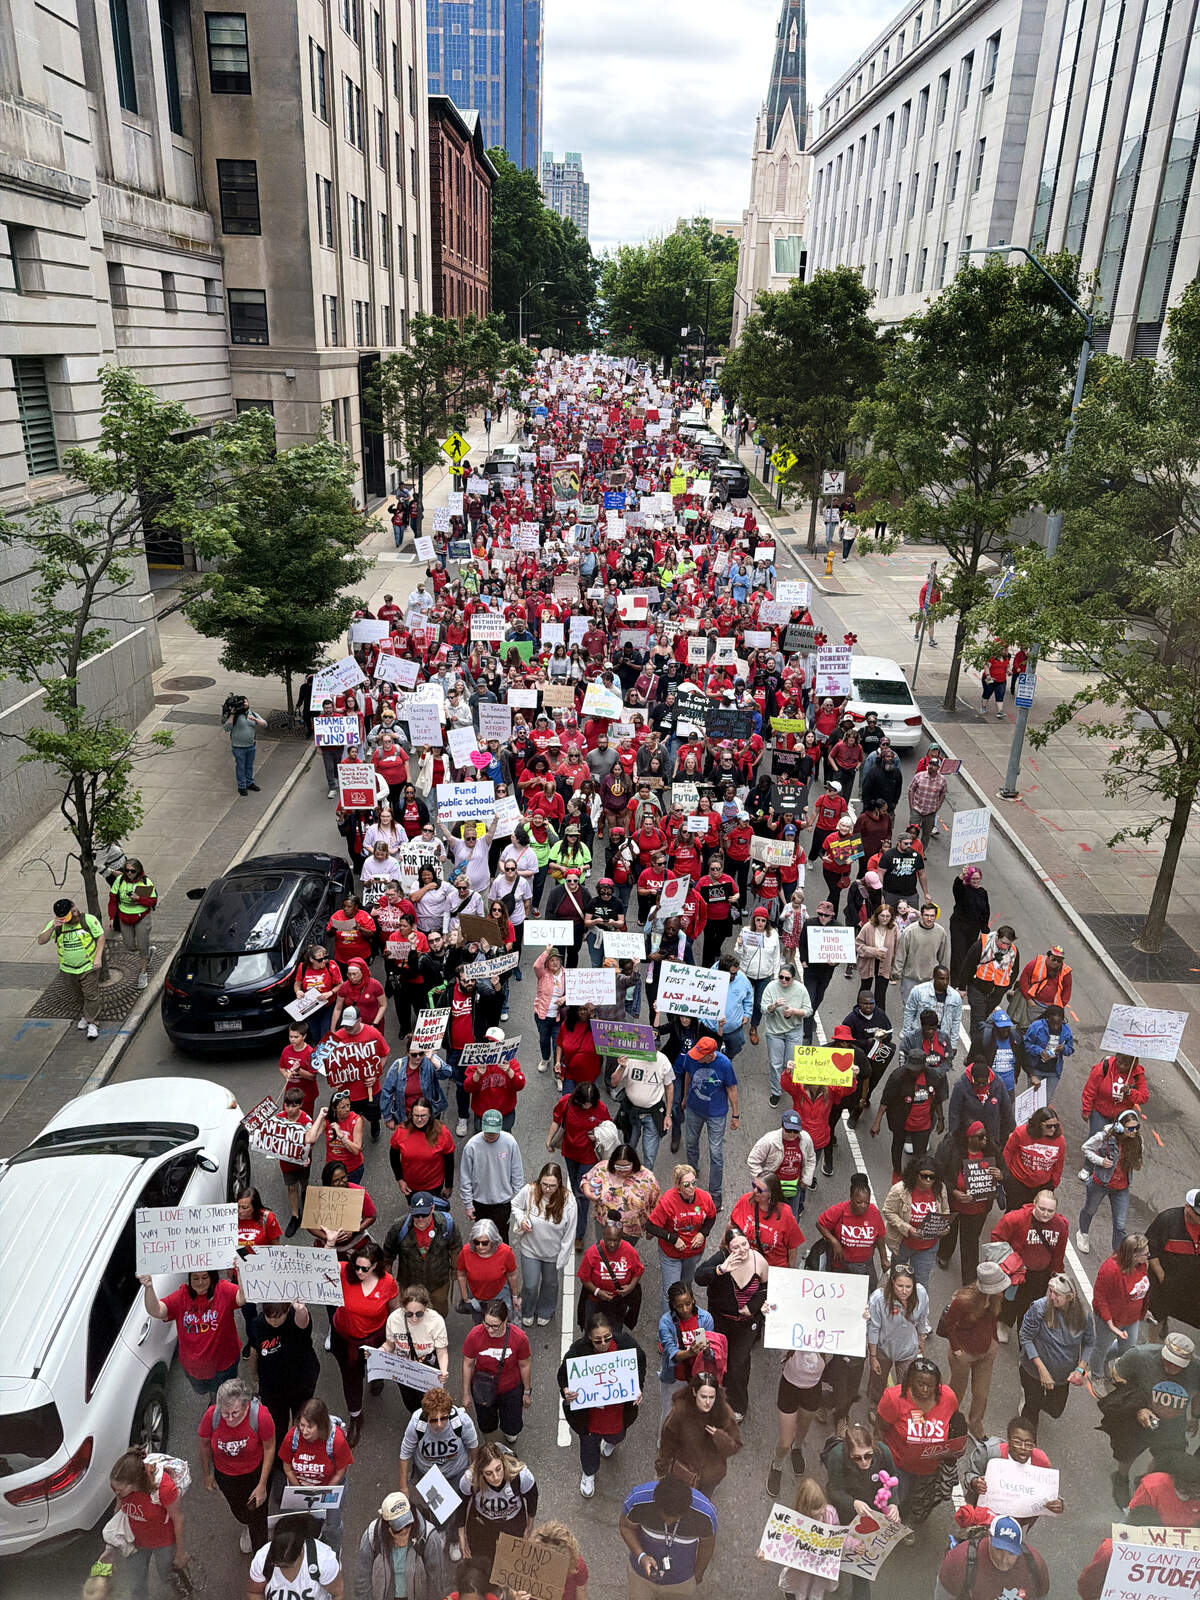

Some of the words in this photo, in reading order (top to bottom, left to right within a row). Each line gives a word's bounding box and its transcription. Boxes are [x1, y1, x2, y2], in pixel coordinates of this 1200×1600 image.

[315, 716, 344, 728] SHAME
[346, 716, 358, 727] ON
[328, 726, 346, 734] YOU
[316, 734, 345, 747] FUND
[346, 732, 360, 746] US
[455, 786, 477, 796] Fund
[777, 786, 803, 796] KIDS
[437, 798, 463, 810] public
[464, 796, 495, 806] schools
[457, 808, 496, 818] vouchers
[403, 855, 418, 866] FOR
[823, 936, 840, 944] FUND
[820, 944, 843, 952] PUBLIC
[817, 952, 847, 960] SCHOOLS
[465, 966, 488, 977] GOOD
[670, 964, 690, 976] North
[664, 976, 686, 985] FIRST
[697, 980, 716, 992] Flight
[662, 991, 684, 1001] LAST
[420, 1009, 450, 1018] TEACHERS
[669, 1002, 689, 1012] FUND
[416, 1025, 445, 1036] ACCEPT
[596, 1022, 612, 1031] LOVE
[614, 1024, 624, 1033] NC
[1129, 1018, 1167, 1034] Kids
[418, 1042, 435, 1050] WORK
[618, 1039, 637, 1048] FUND
[639, 1042, 650, 1050] NC
[329, 1046, 348, 1069] AM
[354, 1040, 379, 1062] NOT
[875, 1043, 893, 1064] KIDS
[261, 1120, 278, 1135] AM
[286, 1127, 305, 1144] NOT
[968, 1163, 979, 1171] WE
[970, 1168, 990, 1177] FULLY
[968, 1175, 993, 1183] FUNDED
[969, 1181, 993, 1190] PUBLIC
[319, 1190, 348, 1202] KIDS
[966, 1186, 997, 1197] SCHOOLS
[137, 1211, 151, 1224] I
[159, 1209, 185, 1223] LOVE
[189, 1208, 202, 1221] MY
[313, 1212, 344, 1226] WAIT
[139, 1229, 158, 1240] WAY
[167, 1225, 182, 1237] TOO
[186, 1226, 209, 1237] MUCH
[212, 1223, 226, 1233] NOT
[841, 1224, 875, 1240] NCAE
[143, 1240, 176, 1255] FIGHT
[185, 1238, 201, 1250] FOR
[207, 1236, 234, 1249] THEIR
[170, 1252, 214, 1271] FUTURE
[267, 1246, 290, 1259] Time
[296, 1248, 307, 1260] to
[313, 1252, 332, 1263] use
[246, 1279, 272, 1300] MY
[273, 1279, 313, 1300] VOICE
[801, 1277, 845, 1299] Pass
[182, 1310, 201, 1327] for
[201, 1308, 219, 1324] the
[815, 1306, 826, 1323] a
[569, 1356, 637, 1381] Advocating
[593, 1368, 619, 1386] IS
[574, 1387, 600, 1405] Our
[602, 1378, 634, 1401] Job!
[1151, 1390, 1189, 1410] VOTE
[421, 1438, 459, 1457] KIDS
[921, 1444, 951, 1457] KIDS
[480, 1496, 519, 1513] KIDS
[774, 1511, 792, 1525] WE
[810, 1524, 826, 1536] OUR
[767, 1529, 782, 1542] WE
[795, 1538, 818, 1554] PUBLIC
[511, 1539, 552, 1566] FUND
[1118, 1545, 1142, 1561] YOU
[1147, 1553, 1183, 1568] CAN'T
[513, 1558, 542, 1580] OUR
[857, 1549, 880, 1577] NC
[496, 1568, 554, 1600] SCHOOLS
[1104, 1589, 1116, 1598] IF
[1119, 1590, 1142, 1600] YOU
